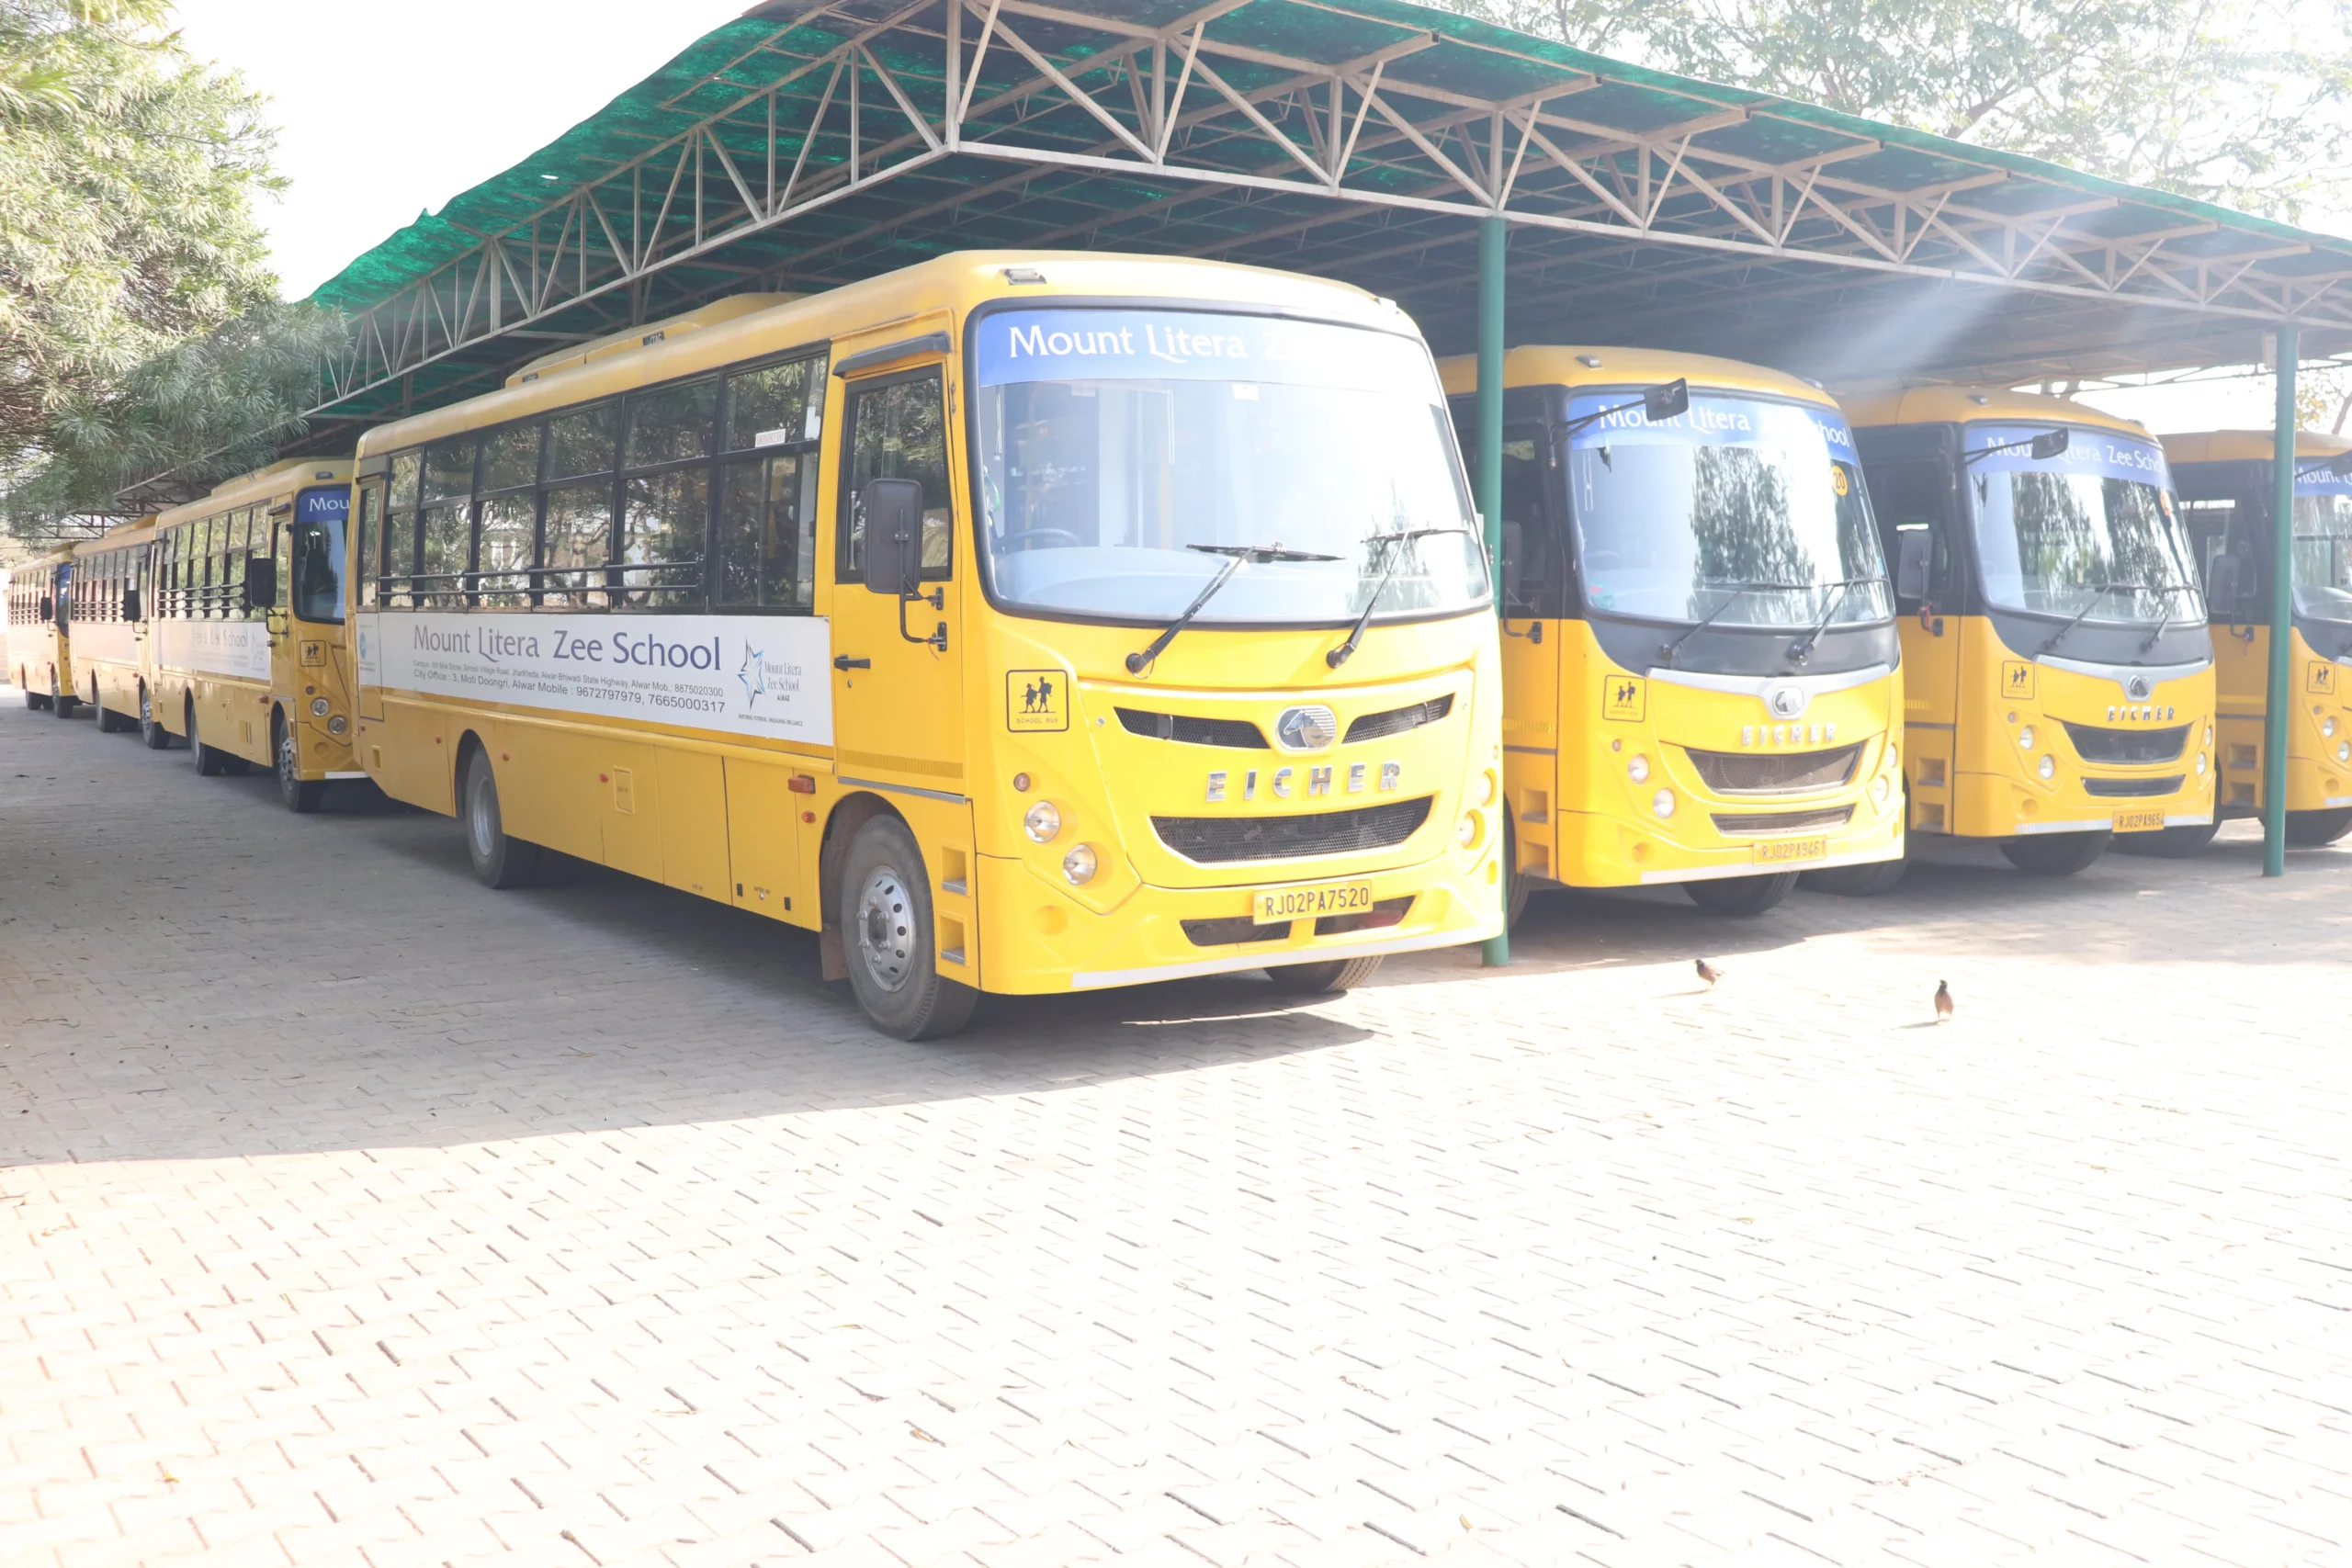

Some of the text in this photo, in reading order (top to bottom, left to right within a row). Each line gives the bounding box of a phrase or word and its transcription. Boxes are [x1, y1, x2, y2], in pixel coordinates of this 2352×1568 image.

[1009, 324, 1136, 358] Mount
[1145, 323, 1249, 365] Litera
[1689, 409, 1751, 436] Litera
[1815, 418, 1850, 449] hool
[1986, 436, 2032, 458] Mou
[2106, 446, 2132, 466] Zee
[1833, 471, 1846, 490] 20
[310, 496, 350, 513] Mou
[413, 625, 721, 672] Mount Litera Zee School
[764, 660, 802, 676] Mount Litera
[413, 669, 426, 681] City
[427, 670, 447, 682] Office
[512, 680, 536, 692] Alwar
[537, 682, 568, 695] Mobile
[648, 694, 726, 713] 7665000317
[582, 675, 599, 685] State
[600, 676, 630, 690] Highway,
[631, 679, 650, 690] Alwar
[674, 682, 724, 698] 8875020300
[766, 676, 800, 693] Zee School
[2107, 705, 2176, 723] EICHER
[1741, 723, 1837, 746] EICHER
[1205, 761, 1402, 803] EICHER
[1264, 886, 1370, 917] RJ02PA7520
